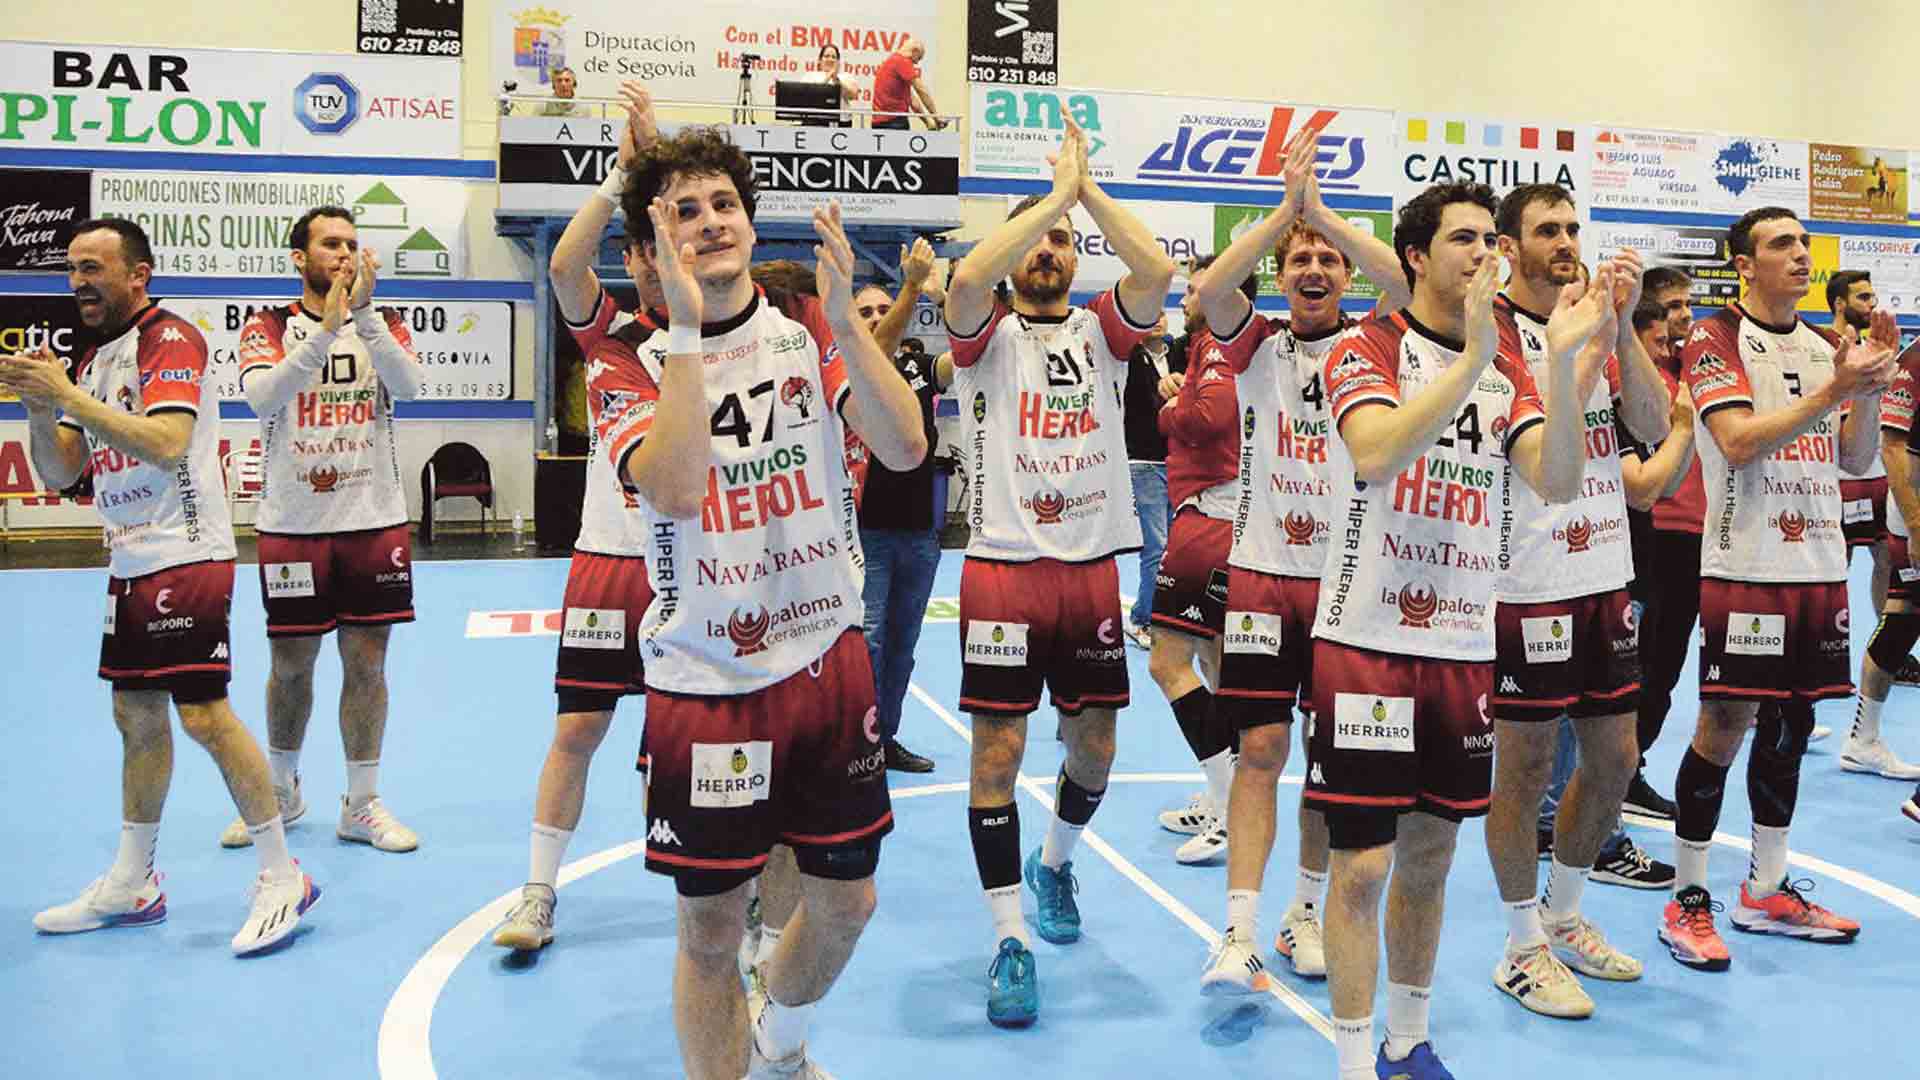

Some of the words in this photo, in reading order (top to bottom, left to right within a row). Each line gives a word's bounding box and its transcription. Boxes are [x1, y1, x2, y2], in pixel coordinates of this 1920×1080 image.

[361, 37, 391, 52] 610
[394, 38, 424, 53] 231
[427, 40, 461, 55] 848
[585, 31, 696, 53] Diputación
[725, 26, 758, 45] Con
[766, 28, 781, 46] el
[791, 26, 833, 48] BM
[53, 50, 190, 93] BAR
[584, 56, 609, 73] de
[616, 57, 696, 80] Segovia
[968, 67, 996, 82] 610
[999, 69, 1024, 84] 231
[1028, 71, 1057, 86] 848
[0, 92, 266, 148] PI-LON
[366, 97, 455, 119] ATISAE
[984, 89, 1102, 130] ana
[1137, 106, 1365, 182] ACEVES
[751, 155, 923, 191] ENCINAS
[1404, 153, 1576, 191] CASTILLA
[101, 178, 220, 204] PROMOCIONES
[225, 180, 345, 206] INMOBILIARIAS
[0, 226, 57, 248] Nava
[221, 214, 295, 251] QUINZ
[1843, 239, 1912, 254] GLASSDRIVE
[172, 254, 192, 274] 45
[199, 254, 218, 275] 34
[238, 255, 259, 274] 617
[416, 352, 491, 365] SEGOVIA
[297, 391, 377, 428] HEROL
[710, 379, 775, 448] 47
[1241, 446, 1254, 487] HIPER
[1345, 498, 1368, 551] HIPER
[1719, 496, 1736, 551] HIERROS
[653, 521, 675, 583] HIPER
[1327, 553, 1359, 627] HIERROS
[1381, 587, 1397, 606] la
[706, 619, 726, 638] la
[769, 593, 843, 630] paloma
[967, 643, 1026, 657] HERRERO
[1729, 634, 1782, 647] HERRERO
[982, 816, 1009, 826] SELECT
